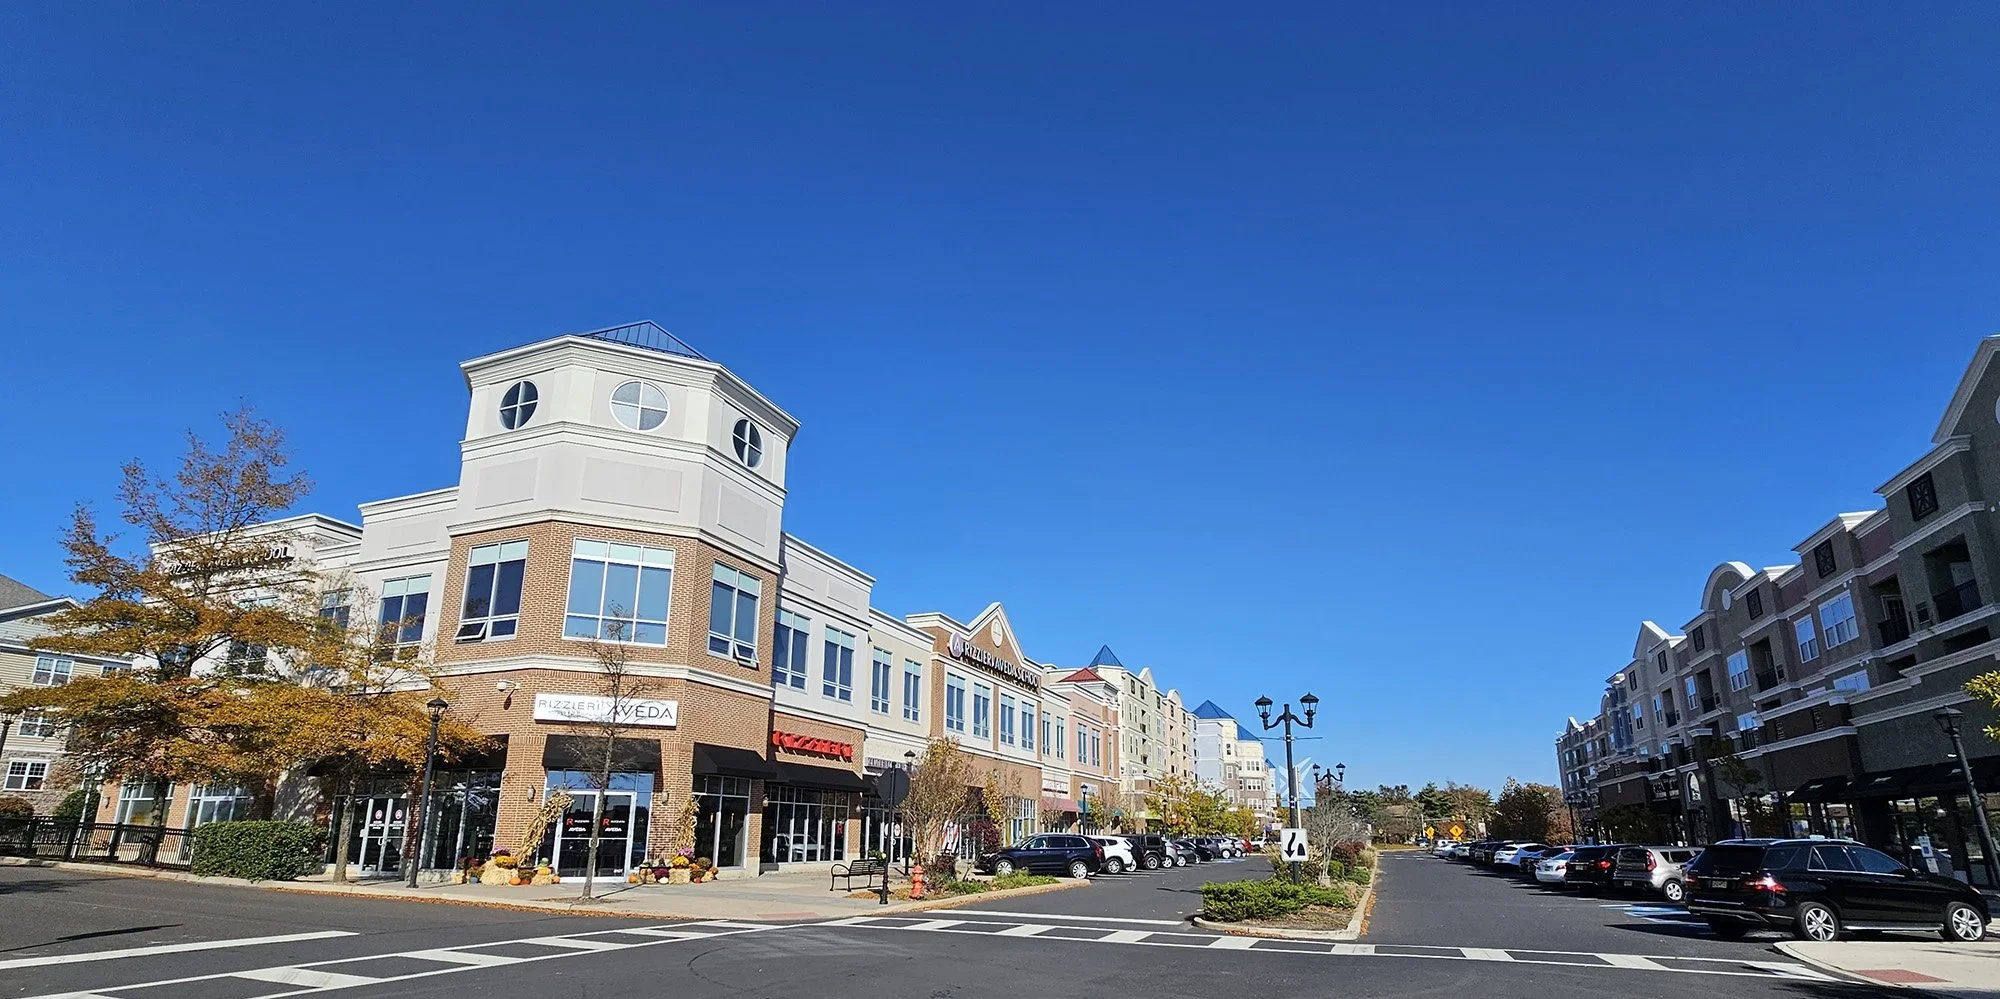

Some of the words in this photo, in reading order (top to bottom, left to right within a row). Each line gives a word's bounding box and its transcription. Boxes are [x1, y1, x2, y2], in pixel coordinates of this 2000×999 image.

[964, 641, 995, 667] RIZZIERI
[995, 656, 1018, 677] AVEDA
[538, 699, 601, 711] RIZZIERI
[607, 704, 673, 719] AVEDA
[566, 818, 574, 826] R
[602, 818, 610, 826] R
